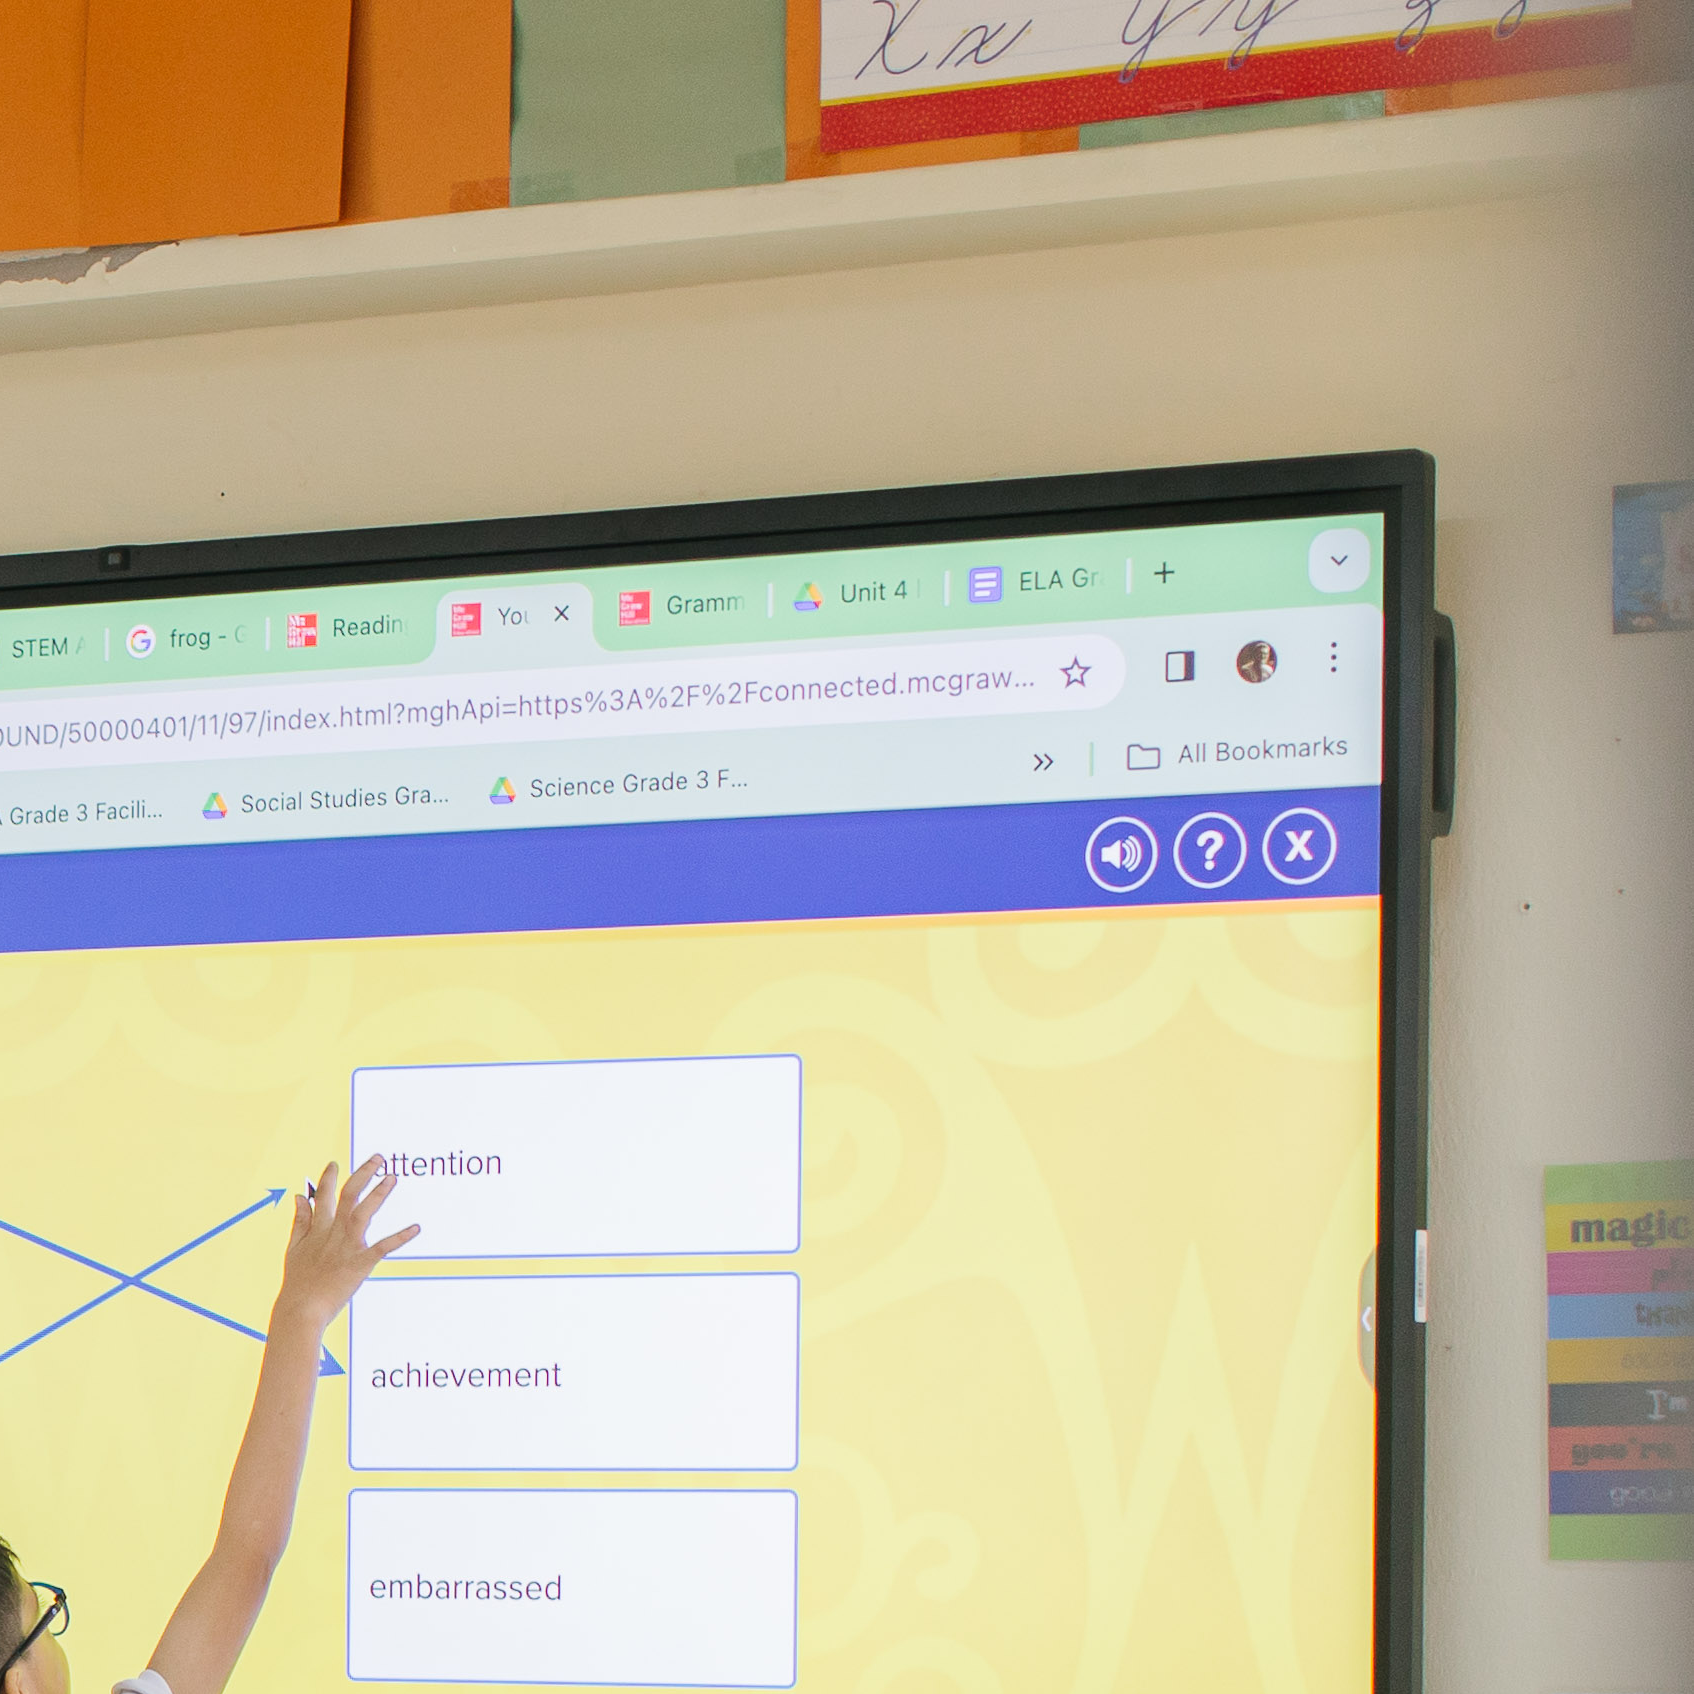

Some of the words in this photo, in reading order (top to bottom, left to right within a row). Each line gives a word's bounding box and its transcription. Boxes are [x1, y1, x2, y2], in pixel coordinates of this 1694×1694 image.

[840, 581, 888, 603] Unit
[892, 581, 907, 600] 4
[1019, 570, 1063, 592] ELA
[12, 639, 68, 659] STEM
[170, 629, 210, 652] frog
[1178, 742, 1207, 764] All
[1216, 735, 1348, 761] Bookmarks
[531, 777, 614, 798] Science
[623, 772, 688, 793] Grade
[696, 771, 709, 788] 3
[718, 769, 747, 787] F...
[9, 805, 69, 824] Grade
[77, 804, 88, 821] 3
[96, 800, 162, 820] Facili...
[241, 792, 302, 813] Social
[311, 788, 388, 810] Studies
[395, 786, 449, 806] Gra...
[1571, 1210, 1692, 1248] magic
[372, 1362, 561, 1388] achievement
[370, 1572, 562, 1601] embarrassed
